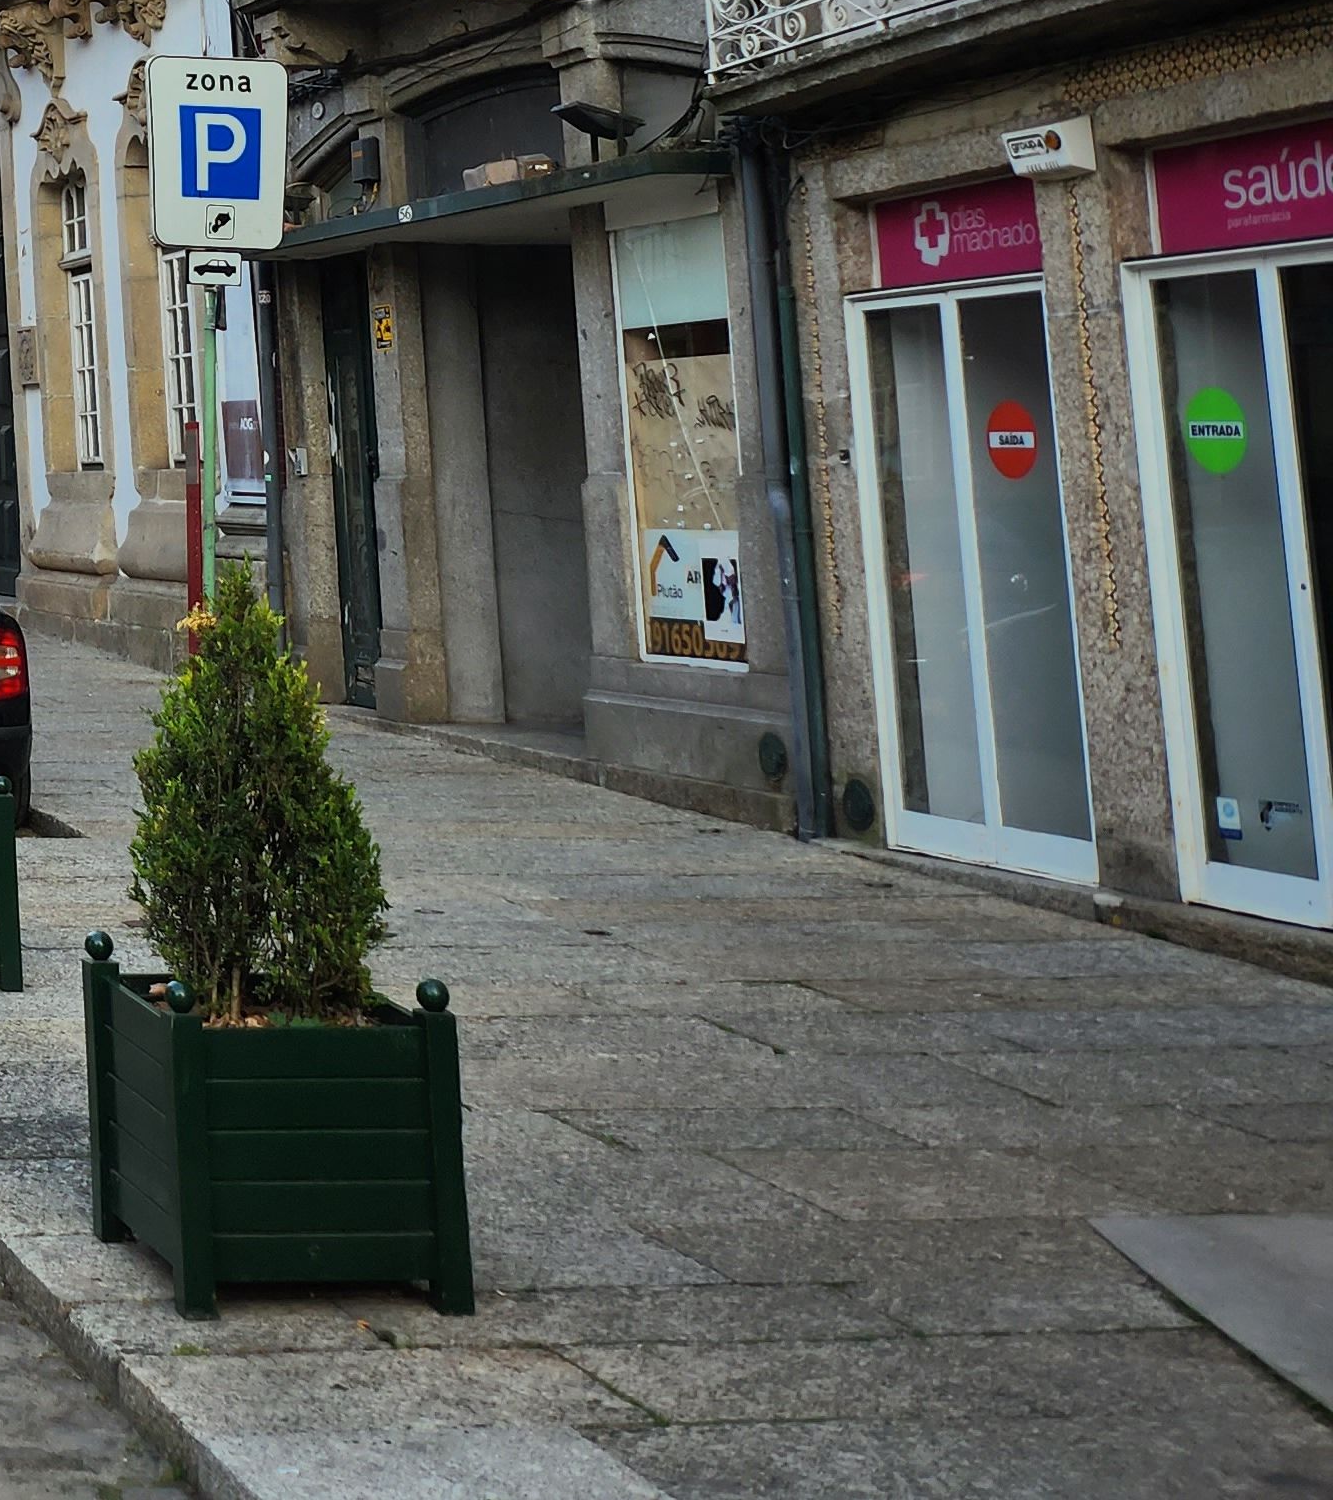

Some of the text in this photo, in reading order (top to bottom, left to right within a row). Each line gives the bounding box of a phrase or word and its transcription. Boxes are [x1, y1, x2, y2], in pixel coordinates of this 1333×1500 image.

[186, 73, 251, 93] zona
[194, 112, 247, 192] P
[399, 206, 412, 221] 56
[950, 206, 986, 232] dias
[952, 220, 1036, 254] machado
[998, 432, 1025, 446] SAÍDA
[1190, 424, 1241, 437] ENTRADA
[657, 583, 683, 599] Plutão
